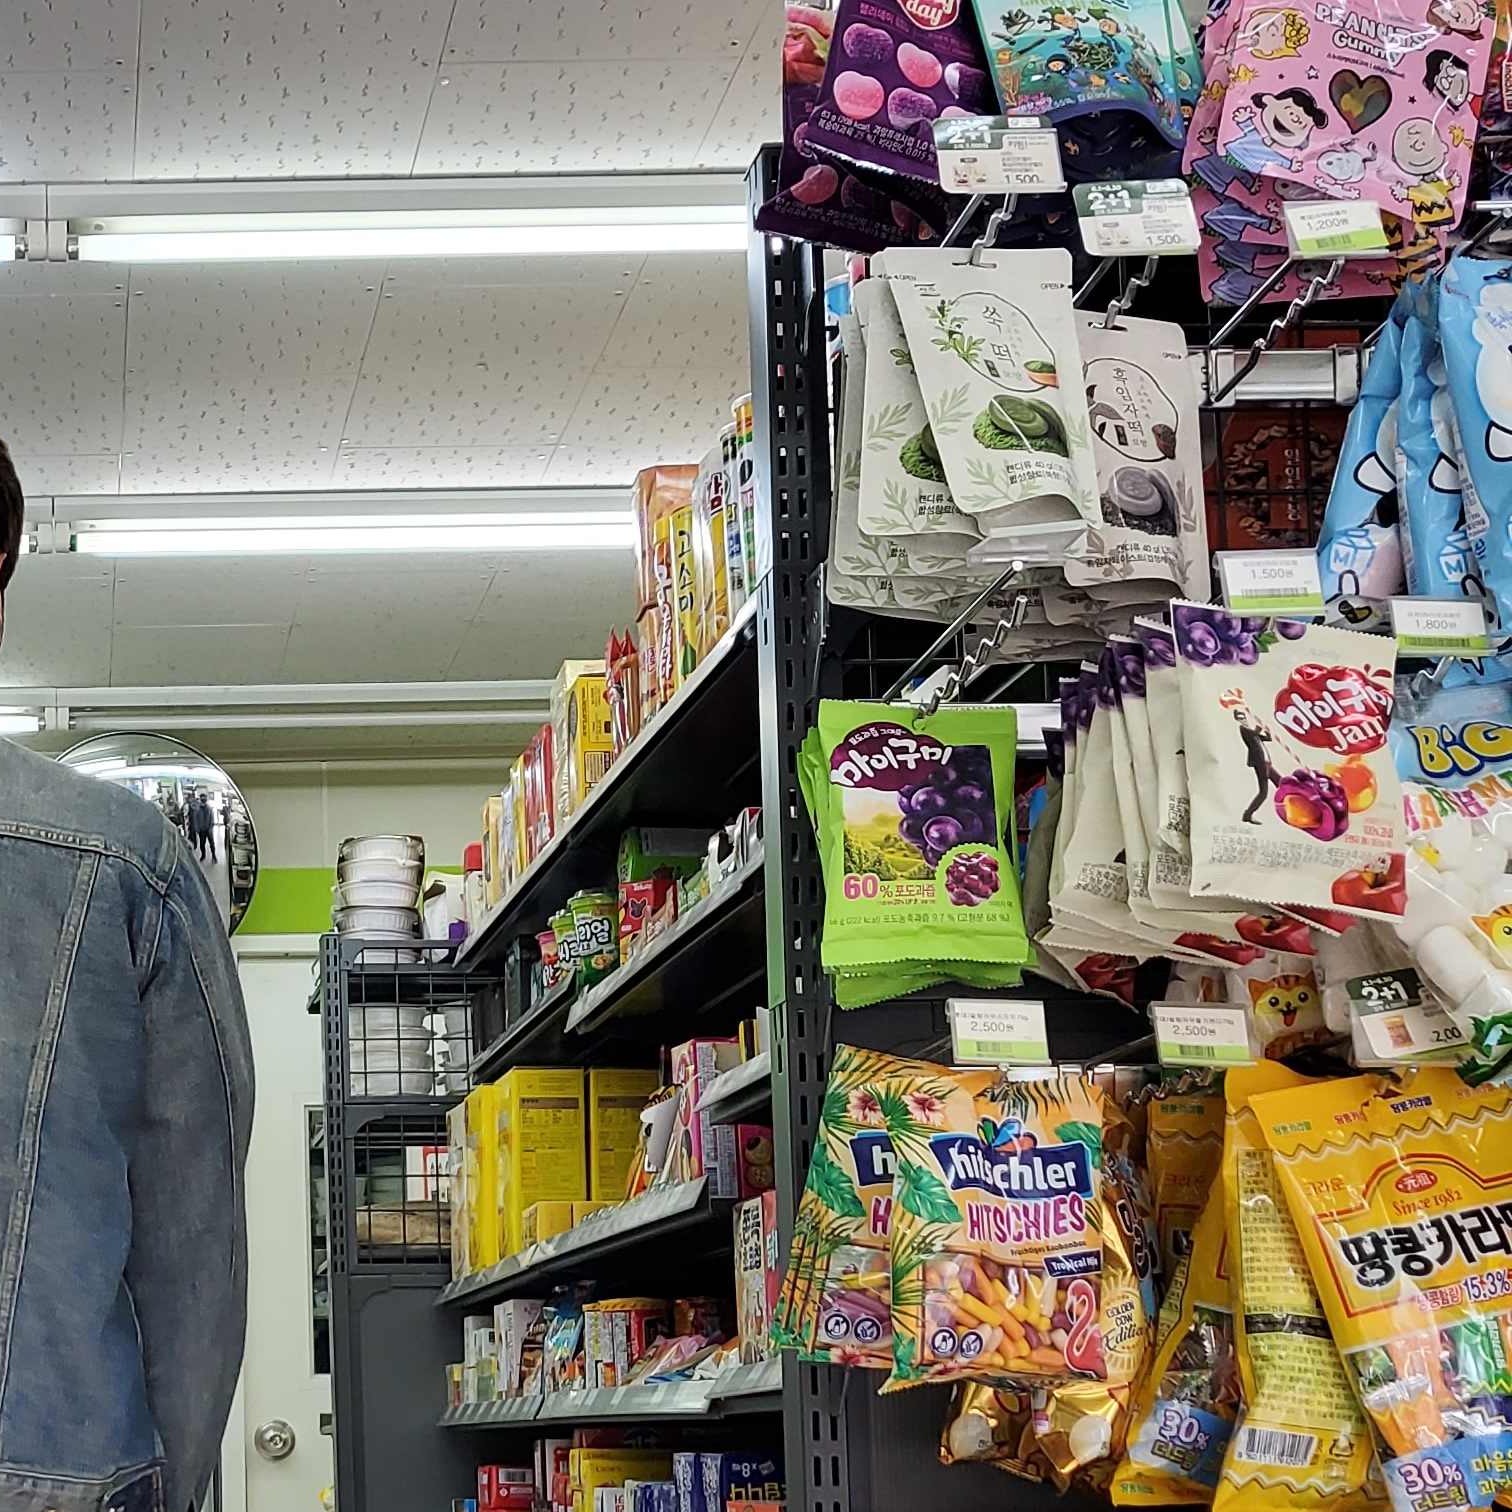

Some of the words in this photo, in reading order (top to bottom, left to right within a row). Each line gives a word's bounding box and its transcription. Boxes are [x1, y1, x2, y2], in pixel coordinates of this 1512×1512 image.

[906, 2, 944, 29] day
[1315, 3, 1428, 51] PEANUTS
[1306, 218, 1350, 232] 1,200원
[1147, 233, 1181, 246] 1,500
[1112, 365, 1145, 437] 흑임자떡
[678, 530, 694, 612] 고소미
[1250, 568, 1293, 579] 1,500원
[1414, 619, 1457, 631] 1,800원
[1275, 677, 1394, 735] 마이구미
[1325, 715, 1385, 752] Jam
[830, 737, 953, 787] 마이구미
[844, 874, 892, 900] 60%
[895, 883, 936, 898] 포도과즙
[846, 916, 862, 926] (222
[1360, 985, 1408, 1009] 2+1
[969, 1021, 1014, 1034] 2,500원
[1172, 1023, 1216, 1036] 2,500원
[1389, 1095, 1433, 1114] 땅콩카라멜
[953, 1144, 1078, 1191] hitschler
[1307, 1176, 1345, 1196] 크라운
[1391, 1198, 1432, 1217] Since
[1433, 1189, 1463, 1207] 1982
[965, 1193, 1086, 1243] HITSCHIES
[1462, 1268, 1511, 1301] 15.3%
[1162, 1408, 1209, 1452] 30%
[1399, 1460, 1463, 1495] 30%
